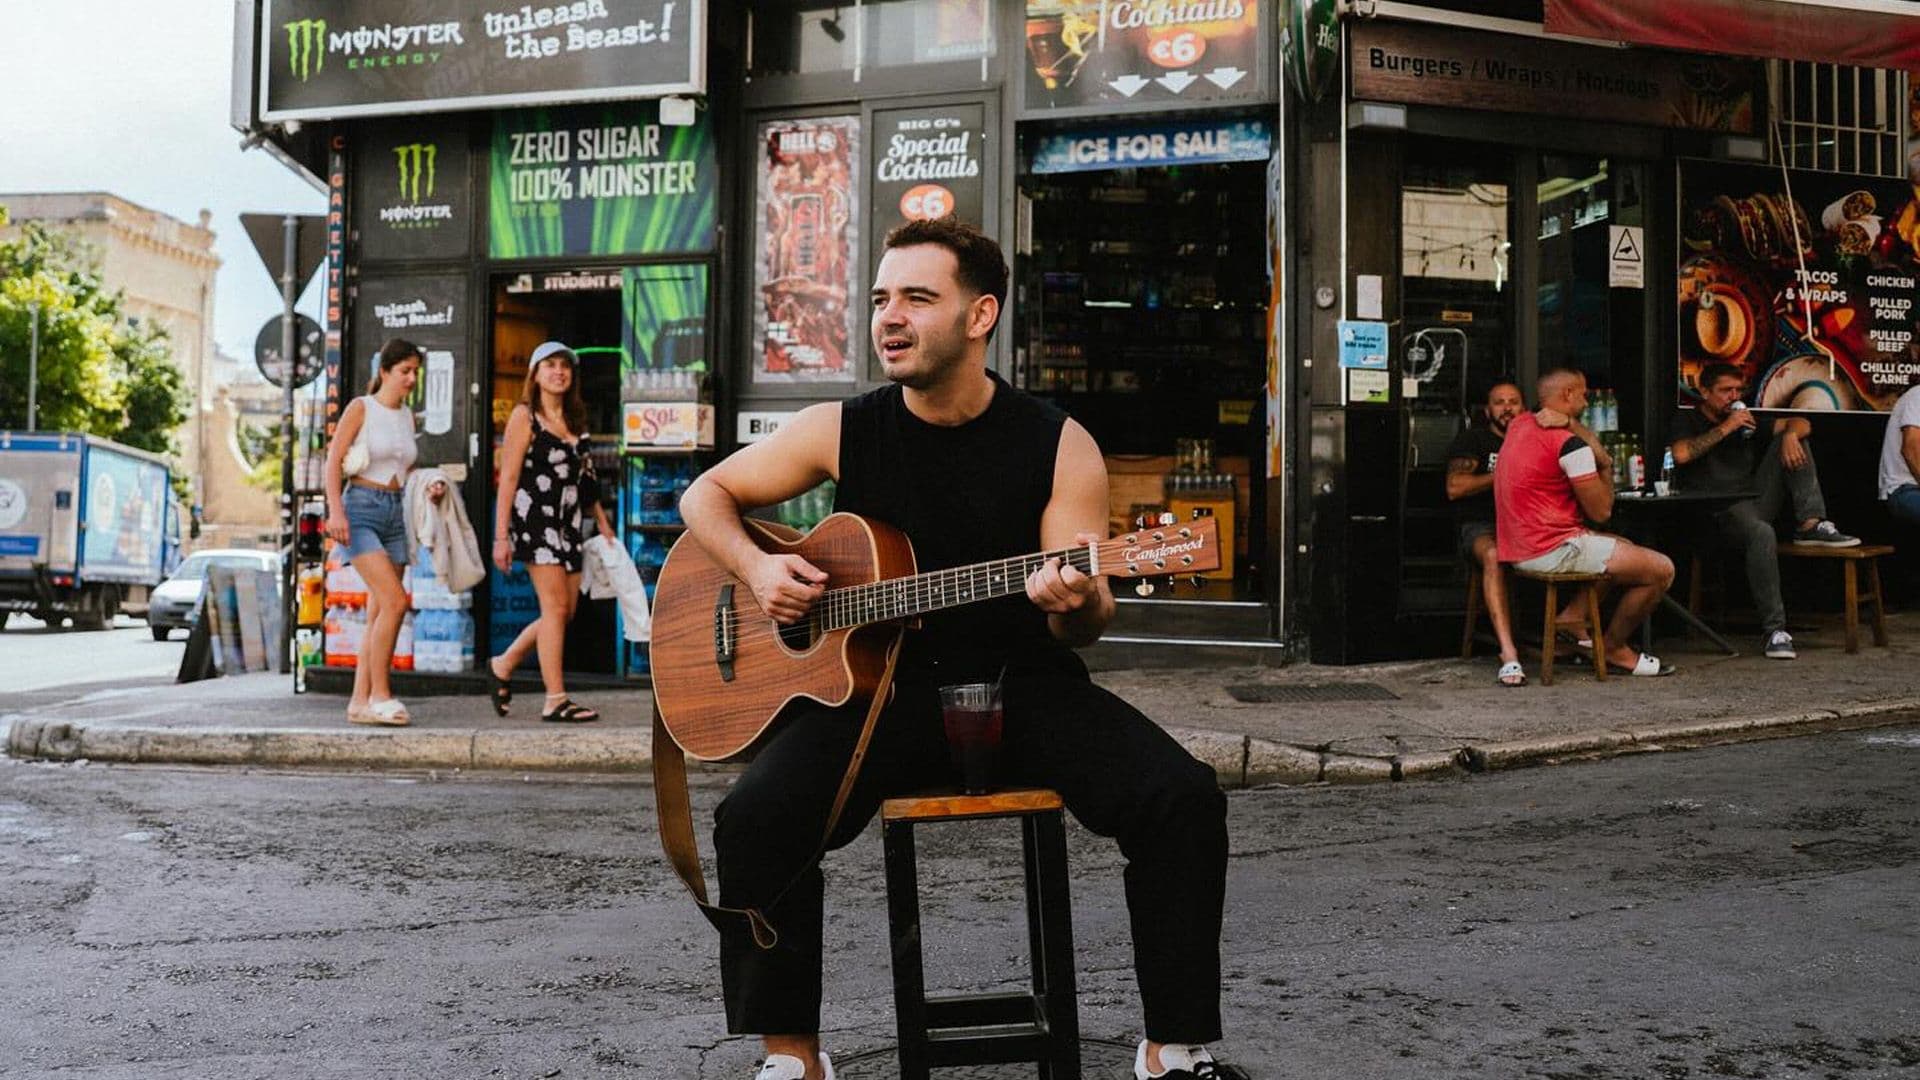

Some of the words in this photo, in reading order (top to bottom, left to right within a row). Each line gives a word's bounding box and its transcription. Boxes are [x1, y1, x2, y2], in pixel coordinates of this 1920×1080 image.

[484, 0, 608, 38] Unleash
[1110, 0, 1243, 29] Cocktails
[329, 22, 464, 55] MONSTER
[505, 33, 560, 60] the
[567, 2, 676, 51] Beast!
[348, 51, 441, 70] ENERGY
[1151, 33, 1196, 62] €6
[1370, 47, 1462, 77] Burgers
[1485, 59, 1555, 89] Wraps
[510, 130, 570, 165] ZERO
[576, 124, 660, 161] SUGAR
[888, 131, 970, 164] Special
[1069, 137, 1110, 164] ICE
[1116, 134, 1167, 160] FOR
[1173, 129, 1231, 156] SALE
[510, 167, 573, 202] 100%
[579, 160, 696, 199] MONSTER
[877, 155, 979, 182] Cocktails
[380, 205, 452, 222] MONSTER
[326, 135, 344, 323] CIGARETTES
[544, 275, 606, 290] STUDENT
[1794, 269, 1838, 284] TACOS
[1866, 275, 1915, 288] CHICKEN
[1785, 287, 1795, 300] &
[1798, 288, 1847, 303] WRAPS
[1869, 297, 1912, 310] PULLED
[1875, 308, 1906, 320] PORK
[1869, 329, 1912, 342] PULLED
[1877, 341, 1905, 352] BEEF
[1860, 361, 1895, 373] CHILLI
[1897, 363, 1920, 375] CON
[1872, 373, 1910, 385] CARNE
[1122, 534, 1204, 562] Tanglewood
